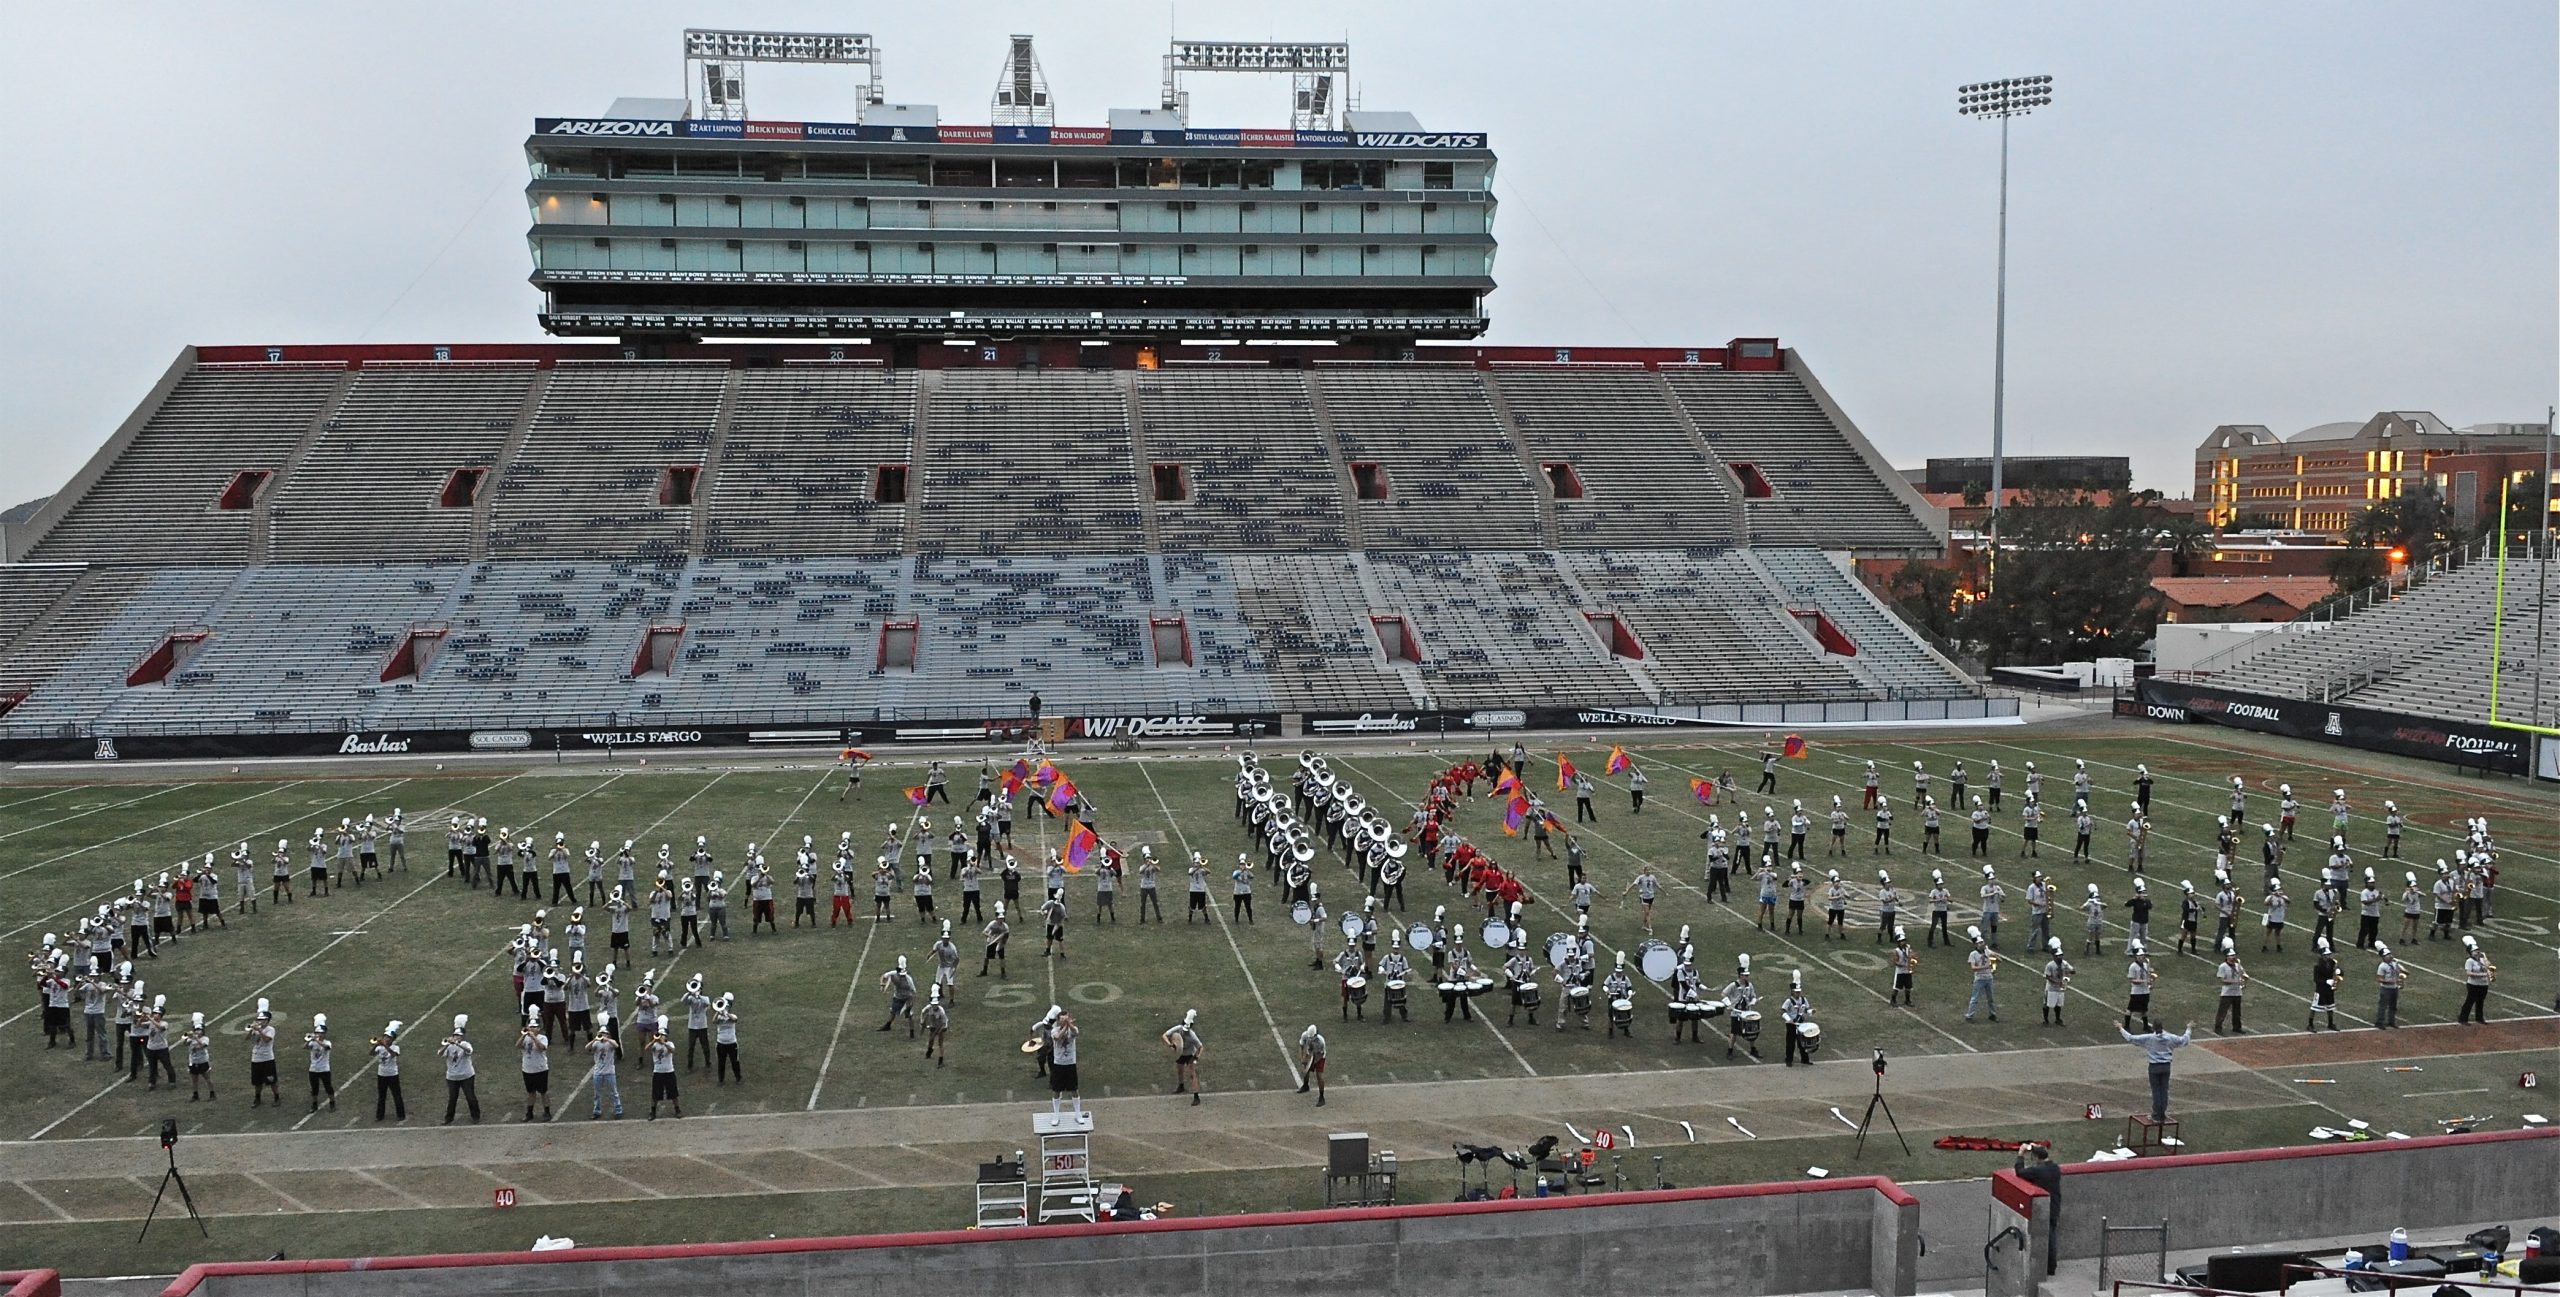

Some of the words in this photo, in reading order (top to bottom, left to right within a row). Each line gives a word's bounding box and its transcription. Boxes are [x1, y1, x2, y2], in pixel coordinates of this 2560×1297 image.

[550, 121, 673, 135] ARIZONA
[690, 123, 698, 132] 22
[699, 124, 711, 132] ART
[755, 126, 775, 134] RICKY
[776, 126, 802, 134] HUNLEY
[813, 127, 837, 135] CHUCK
[838, 128, 857, 136] CECIL
[1074, 132, 1105, 140] WALDROP
[1194, 132, 1208, 140] STEVE
[1208, 133, 1240, 141] McLAUGHLIN
[1247, 133, 1264, 141] CHRIS
[1264, 133, 1295, 142] McALISTER
[1301, 134, 1327, 142] ANTOINE
[1328, 135, 1349, 143] CASON
[1356, 134, 1480, 147] WILDCATS
[268, 353, 280, 362] 17
[436, 351, 448, 361] 18
[624, 351, 635, 360] 19
[830, 351, 844, 360] 20
[984, 351, 996, 360] 21
[1208, 352, 1221, 361] 22
[1402, 352, 1415, 361] 23
[1557, 354, 1569, 362] 24
[1686, 355, 1698, 363] 25
[2148, 706, 2184, 721] DOWN
[2226, 702, 2280, 721] FOOTBALL
[1578, 713, 1627, 723] WELLS
[590, 732, 646, 744] WELLS
[648, 731, 702, 742] FARGO
[339, 734, 411, 753] Bashas'
[982, 982, 1124, 1008] 50
[2524, 1073, 2536, 1087] 20
[2089, 1104, 2102, 1119] 30
[1596, 1132, 1610, 1148] 40
[1057, 1155, 1072, 1170] 50
[497, 1190, 514, 1206] 40
